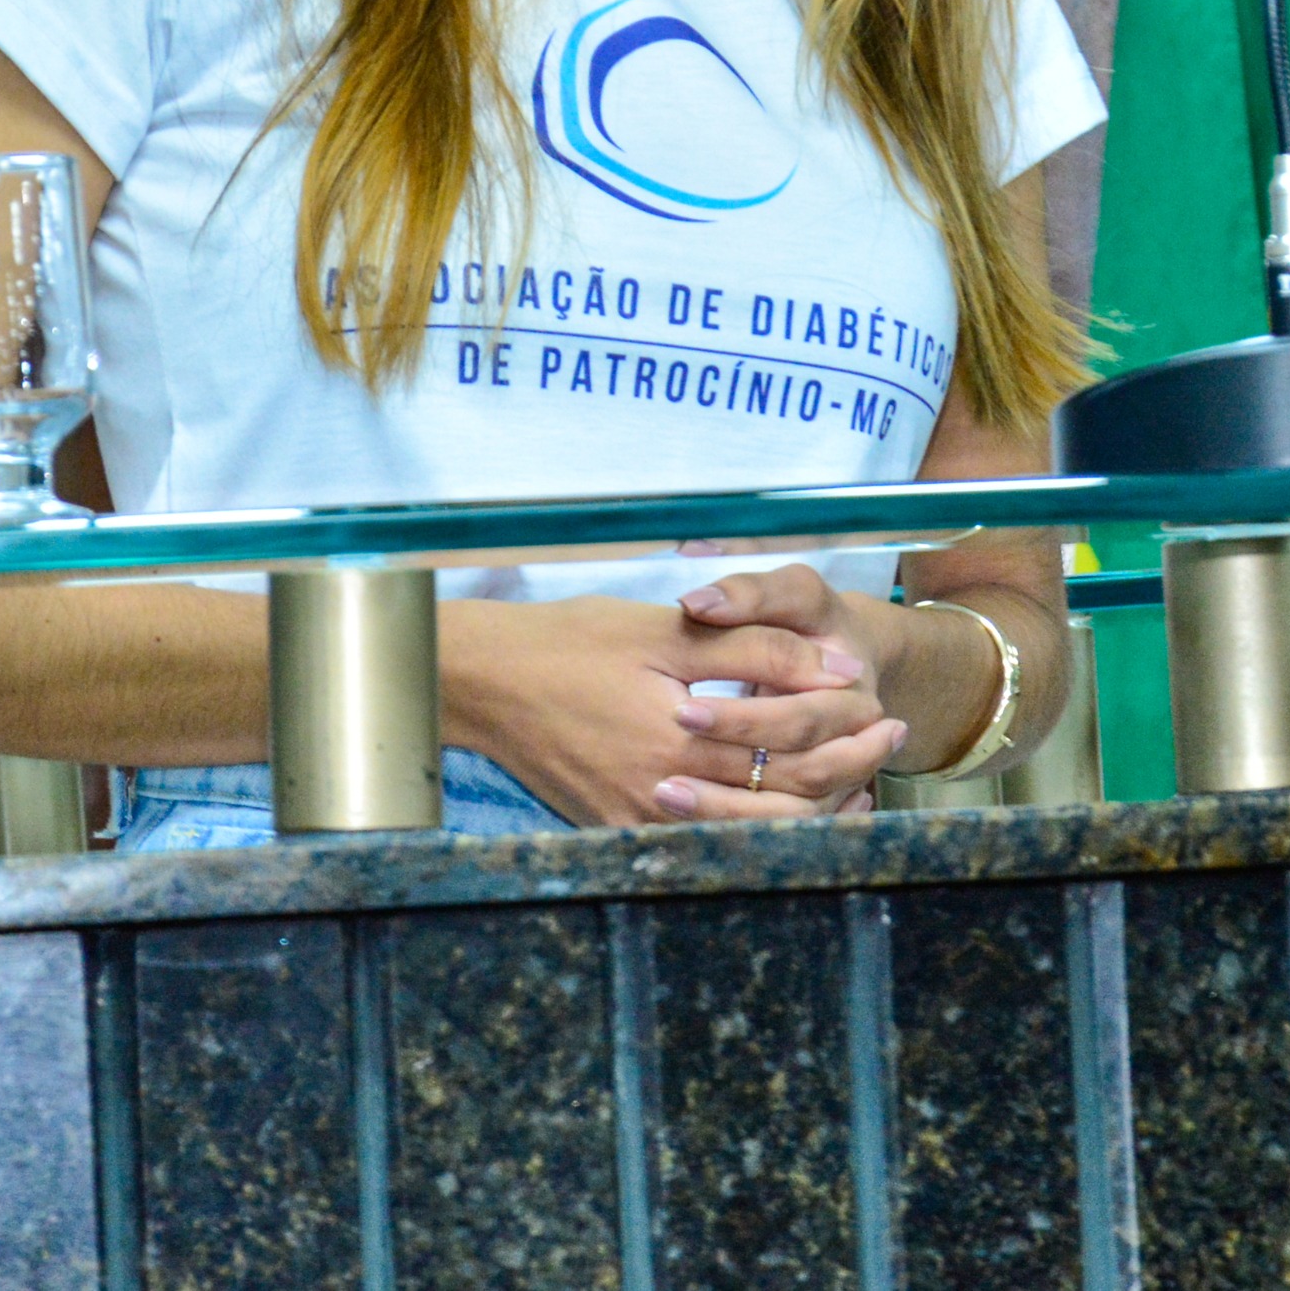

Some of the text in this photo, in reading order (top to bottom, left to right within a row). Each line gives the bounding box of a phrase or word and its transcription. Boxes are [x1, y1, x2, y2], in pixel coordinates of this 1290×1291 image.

[325, 261, 641, 321] ASOCIAÇÃO
[668, 283, 724, 332] DE
[458, 340, 898, 442] DE PATROCÍNIO-MG
